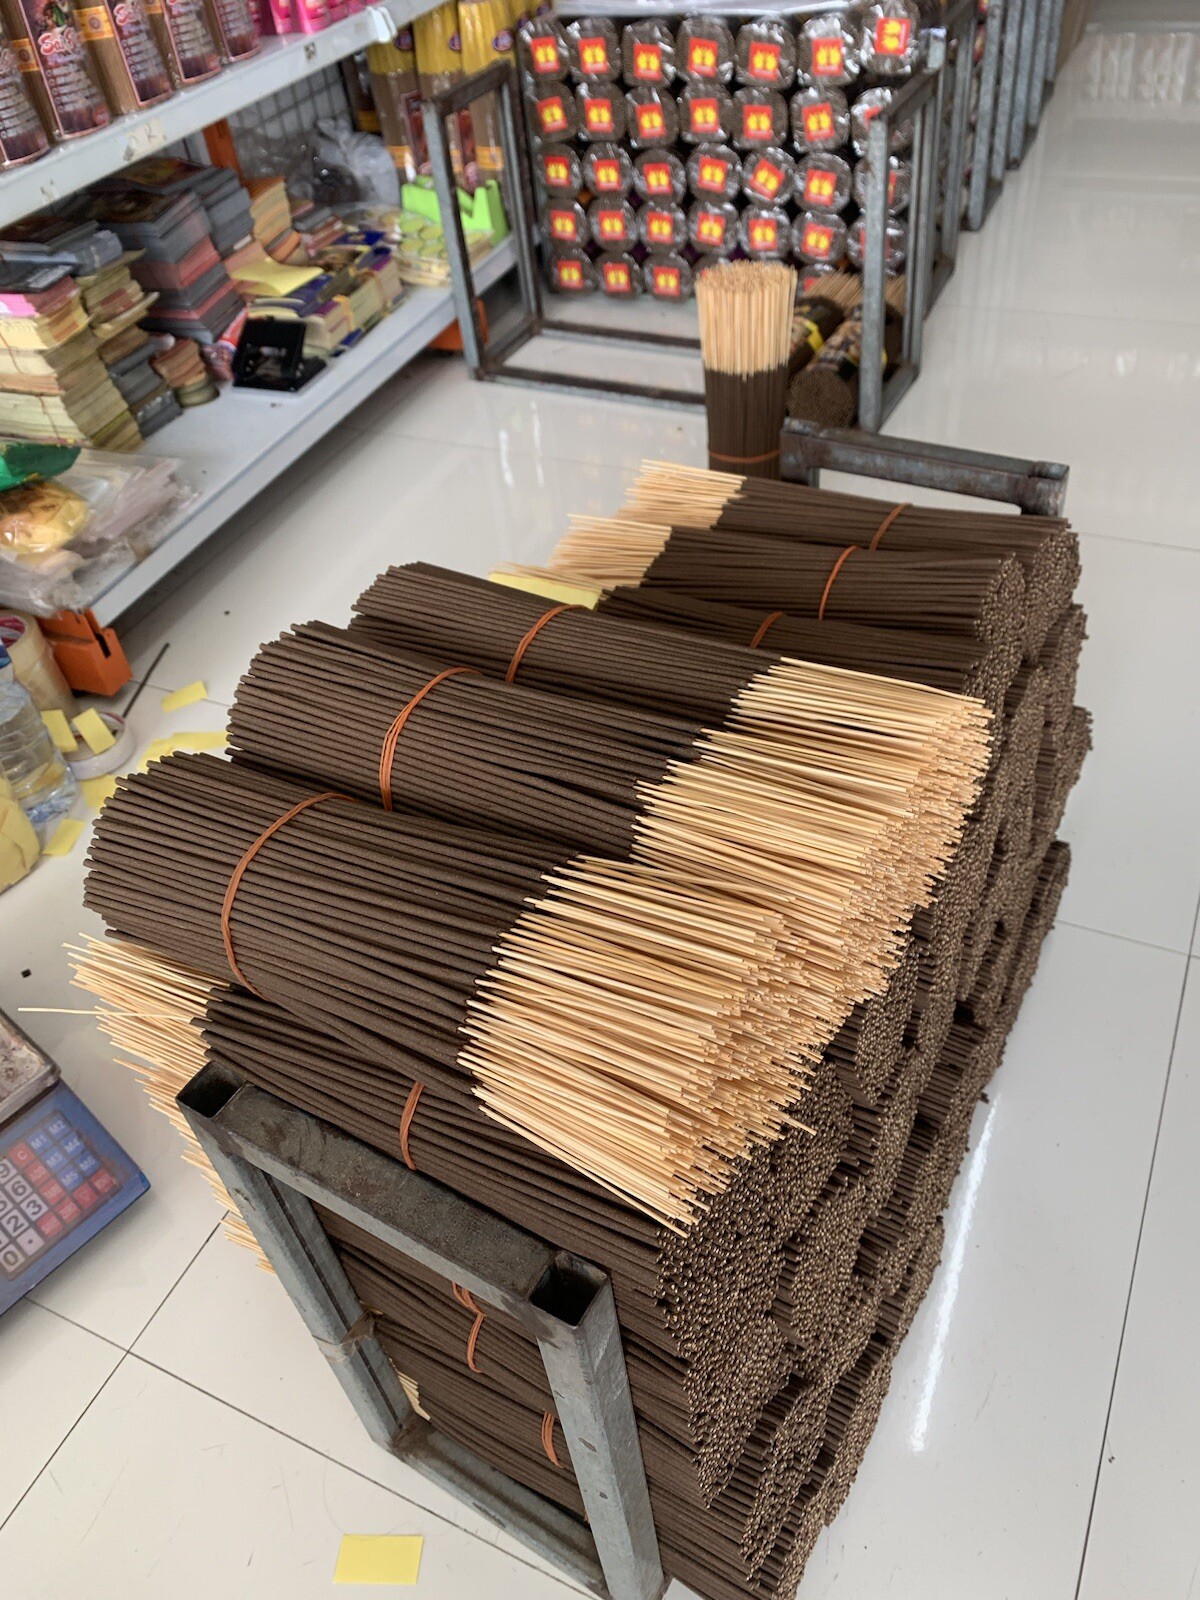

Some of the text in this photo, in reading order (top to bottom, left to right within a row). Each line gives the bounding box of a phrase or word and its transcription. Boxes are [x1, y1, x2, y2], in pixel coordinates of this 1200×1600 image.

[48, 1120, 66, 1135] M2
[30, 1134, 47, 1150] M1
[63, 1138, 81, 1154] M4
[17, 1150, 27, 1160] C
[46, 1152, 63, 1168] M3
[60, 1170, 78, 1186] M5
[11, 1180, 27, 1196] 6
[26, 1200, 42, 1215] 3
[6, 1215, 24, 1232] 2
[3, 1251, 18, 1266] 0
